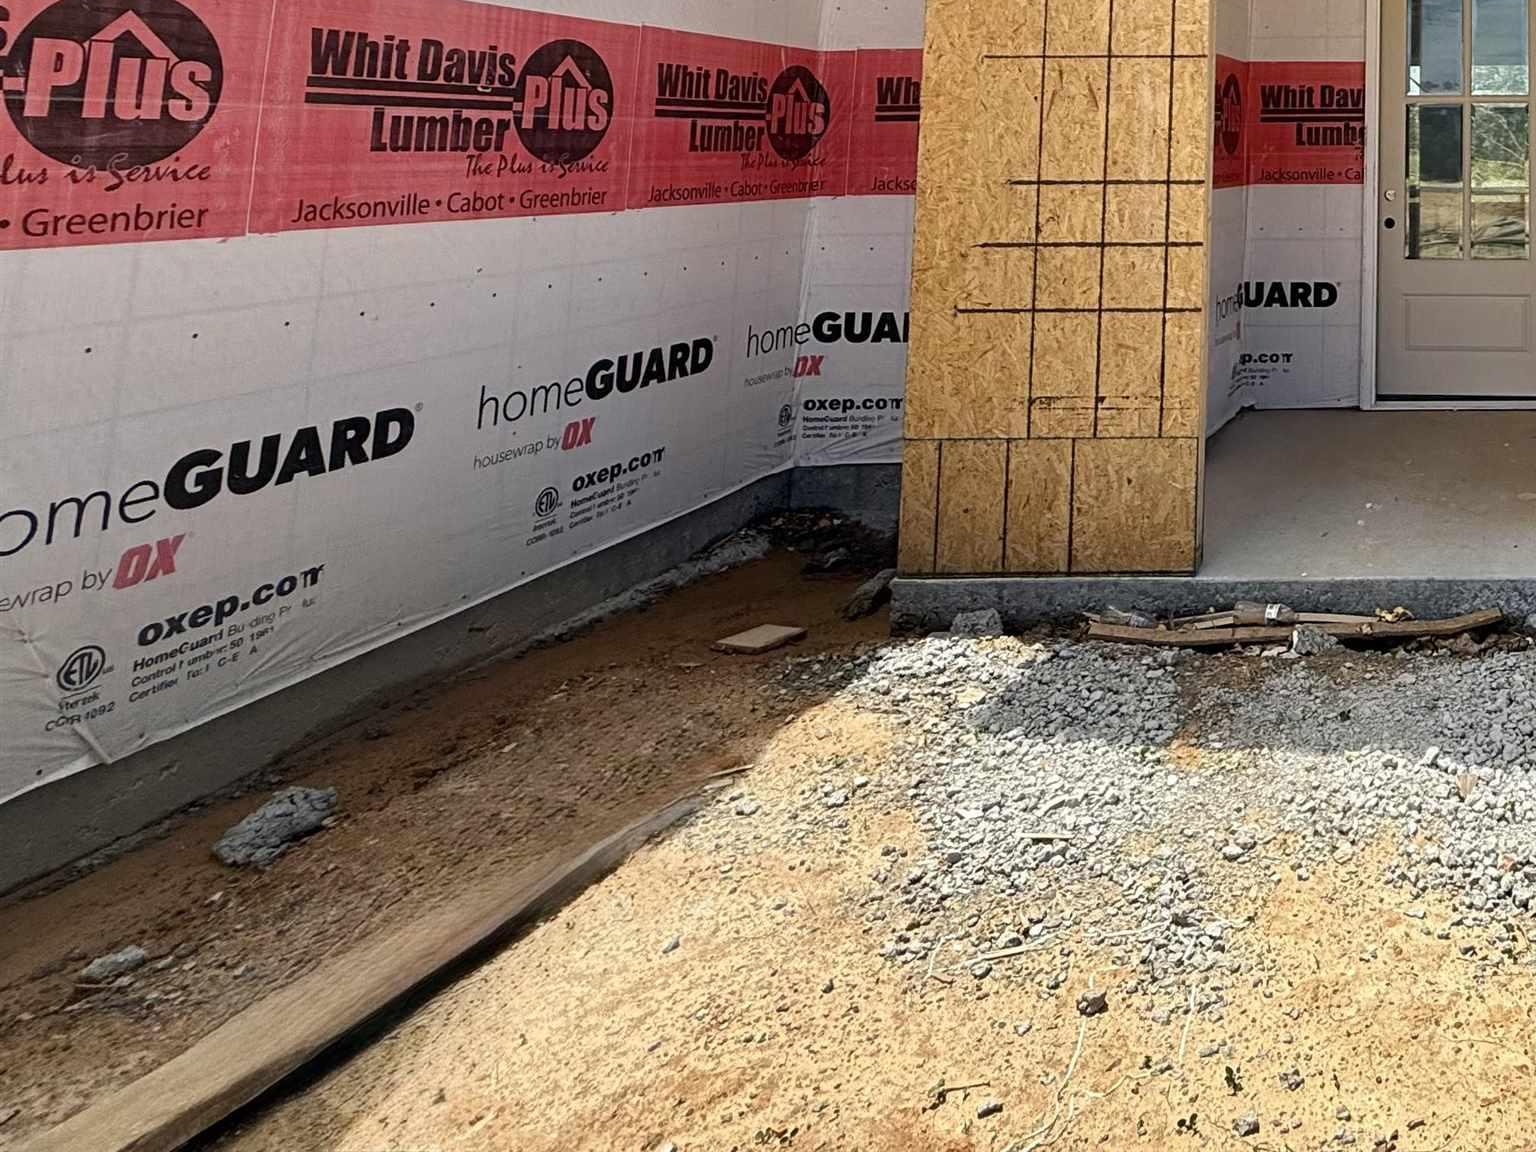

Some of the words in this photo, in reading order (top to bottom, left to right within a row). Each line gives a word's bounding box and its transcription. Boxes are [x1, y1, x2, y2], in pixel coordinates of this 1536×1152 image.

[310, 27, 411, 82] Whit
[416, 38, 517, 88] Davis
[22, 35, 213, 123] Plus
[657, 61, 711, 97] Whit
[714, 67, 769, 103] Davis
[1260, 84, 1315, 108] Whit
[521, 74, 609, 132] Plus
[771, 92, 825, 136] Plus
[369, 107, 513, 153] Lumber
[689, 118, 766, 152] Lumber
[63, 154, 97, 185] is
[102, 152, 212, 192] Service
[465, 154, 492, 179] The
[496, 154, 533, 179] Plus
[557, 152, 610, 180] Service
[1258, 168, 1335, 182] Jacksonville
[291, 192, 431, 224] Jacksonville
[446, 190, 505, 214] Cabot
[519, 186, 609, 210] Greenbrier
[648, 183, 722, 202] Jacksonville
[730, 180, 763, 198] Cabot
[769, 177, 826, 195] Greenbrier
[21, 202, 210, 237] Greenbrier
[745, 310, 910, 358] homeGUA
[476, 336, 719, 430] homeGUARD
[793, 354, 825, 379] OX
[472, 438, 545, 471] housewrap
[545, 434, 562, 452] by
[561, 416, 597, 452] OX
[81, 567, 114, 592] by
[111, 532, 188, 592] OX
